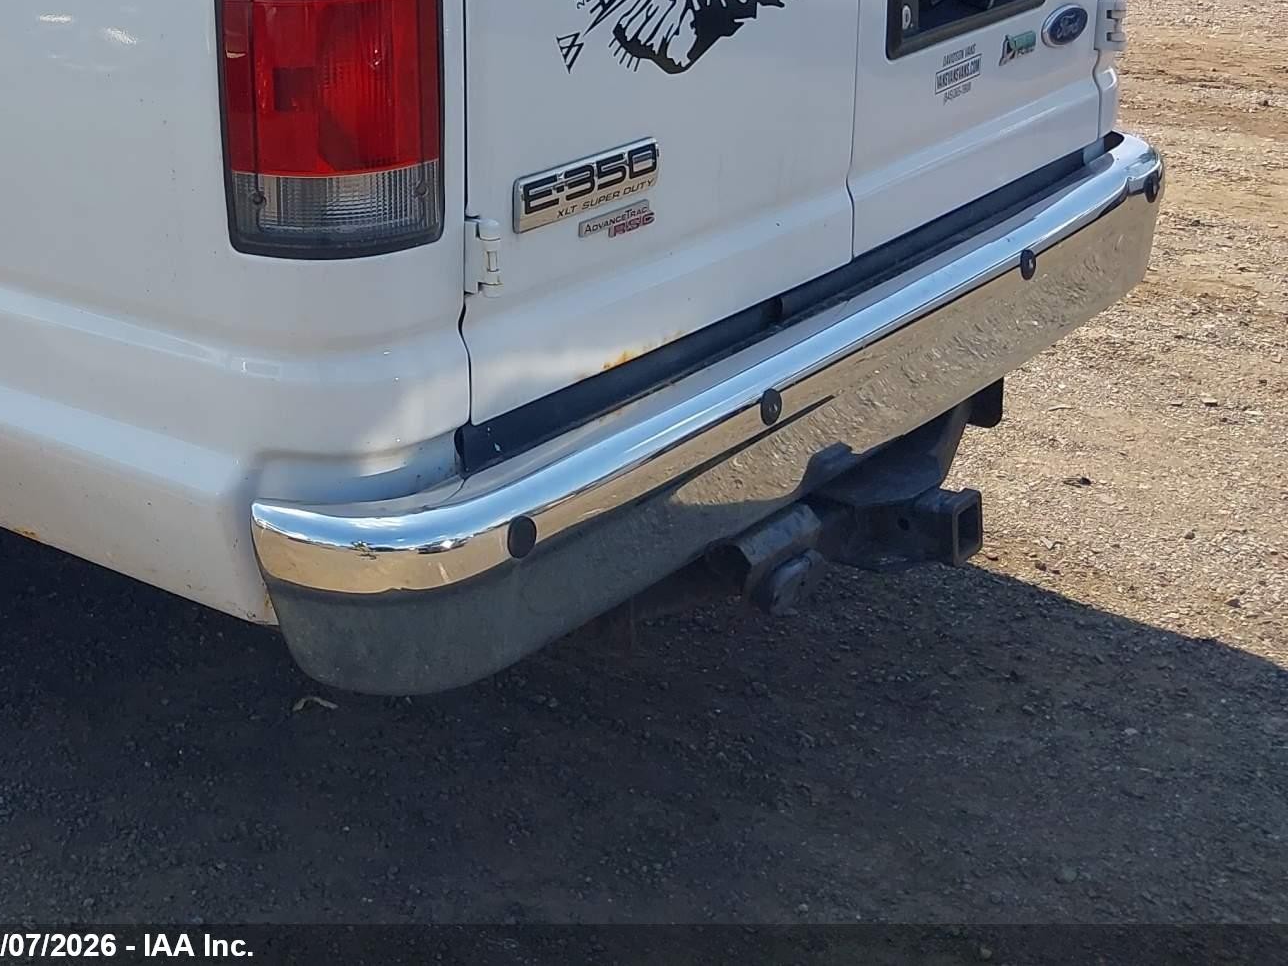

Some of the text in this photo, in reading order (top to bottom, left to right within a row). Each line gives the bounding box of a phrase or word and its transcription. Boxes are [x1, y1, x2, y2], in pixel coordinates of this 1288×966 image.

[523, 143, 658, 215] E-350
[557, 178, 655, 219] XLT SUPER DUTY
[612, 212, 655, 237] RSC
